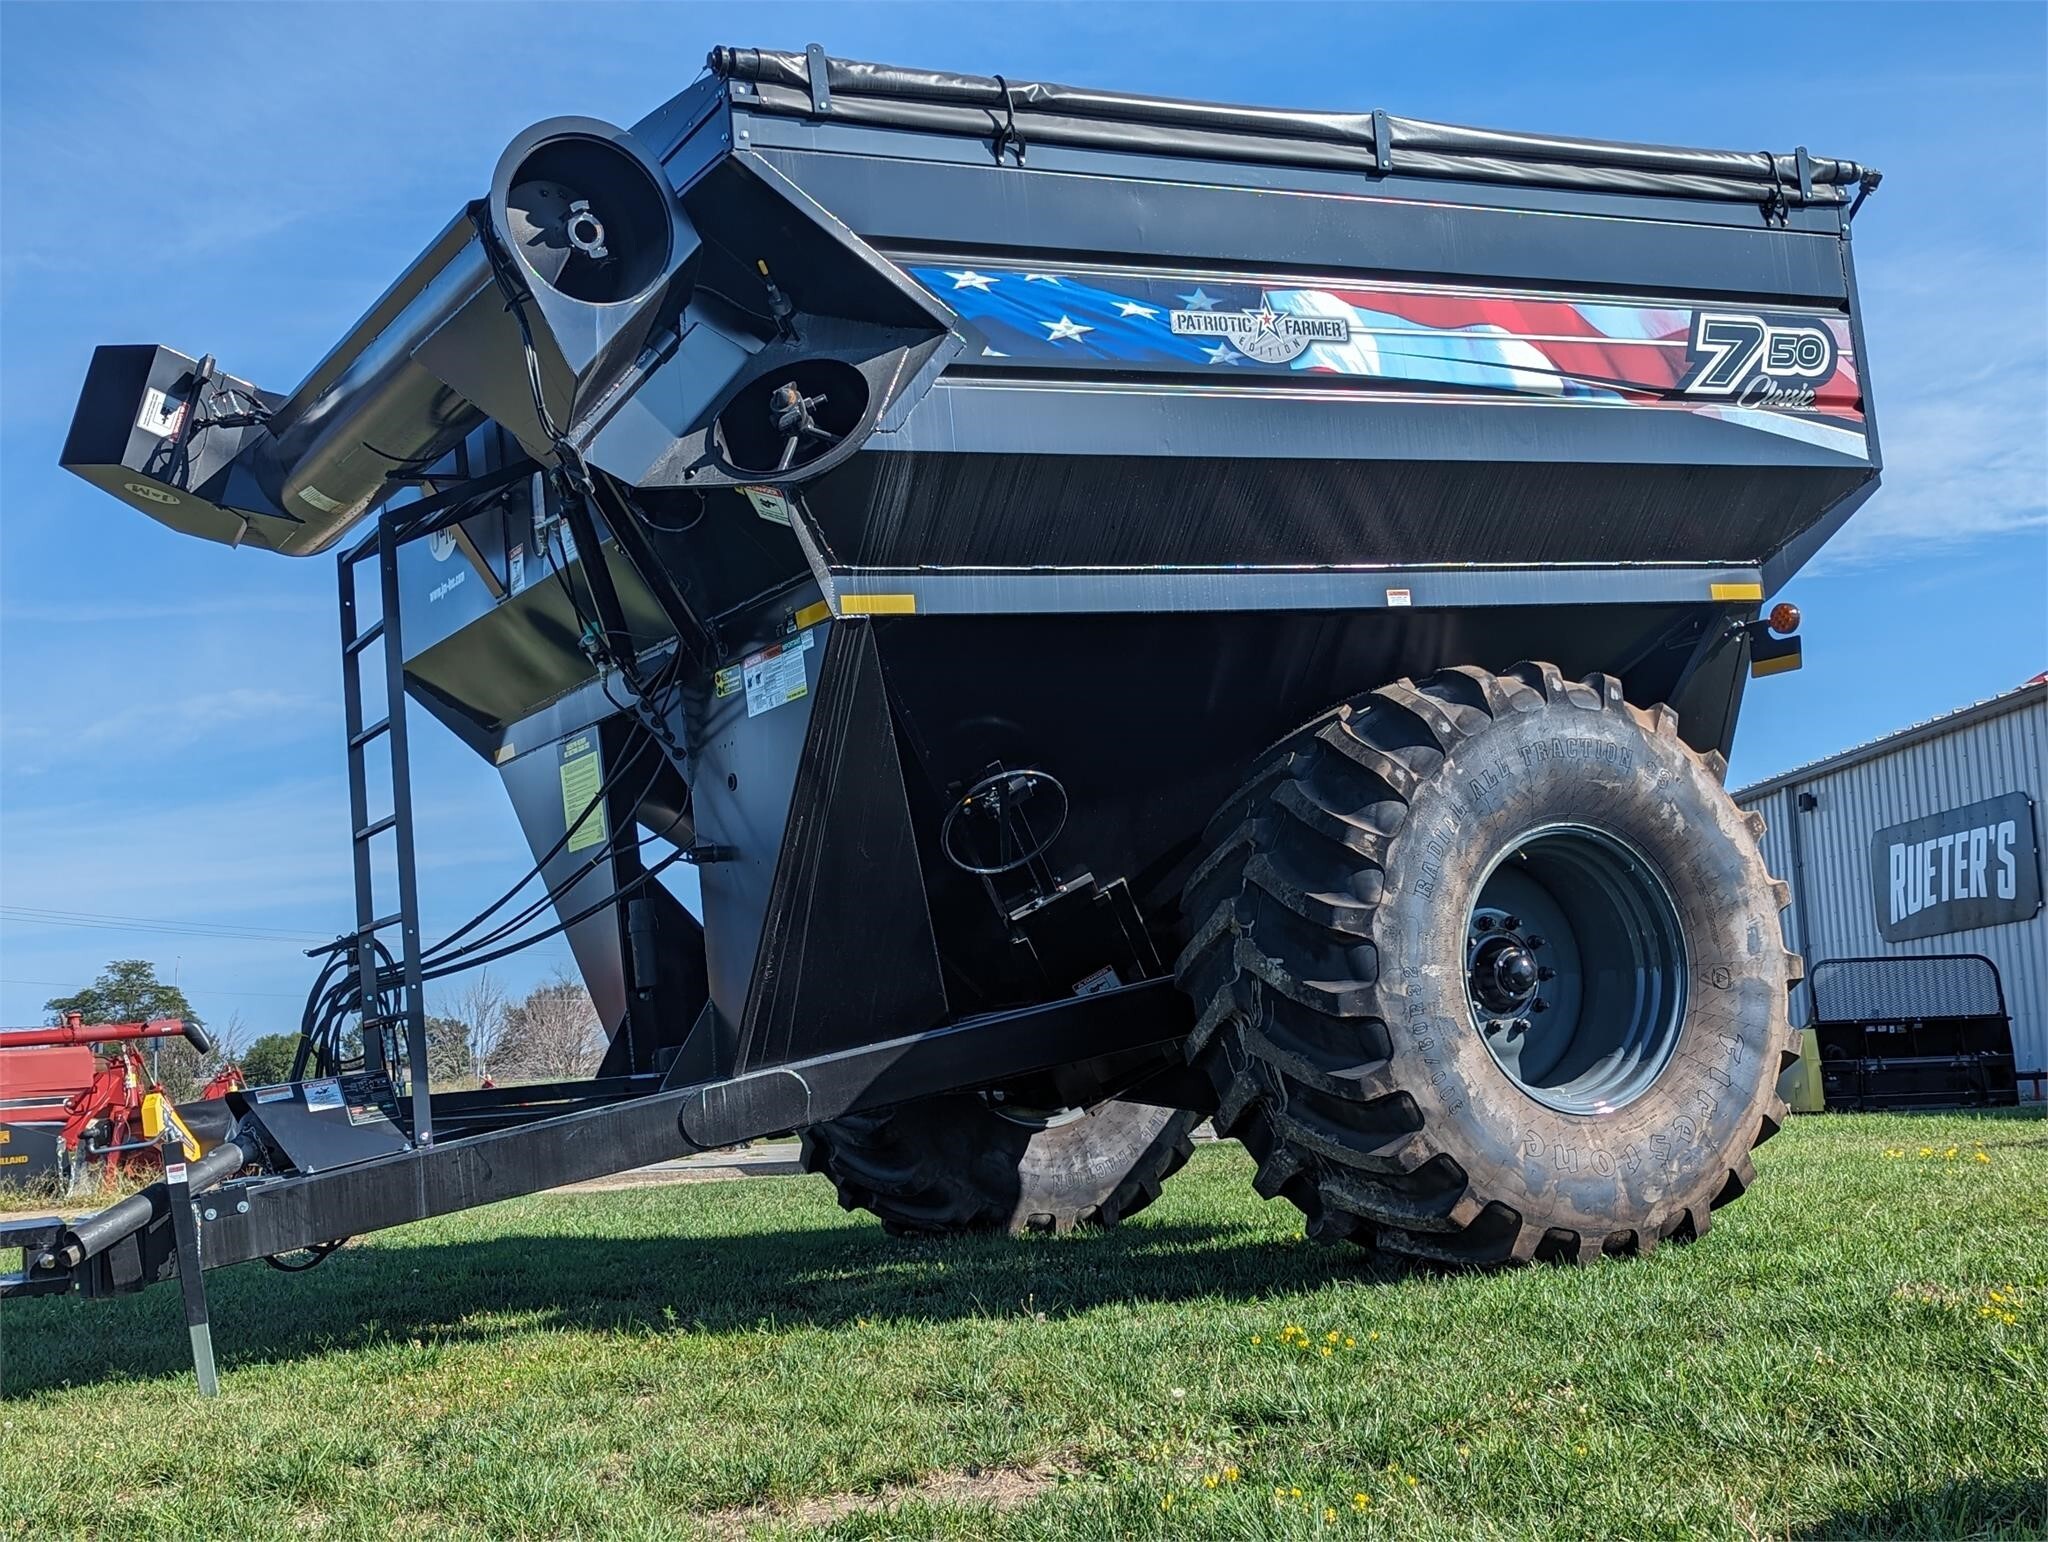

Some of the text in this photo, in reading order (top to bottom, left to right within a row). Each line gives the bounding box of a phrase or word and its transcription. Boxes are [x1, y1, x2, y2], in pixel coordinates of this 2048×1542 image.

[1177, 314, 1341, 337] PATRIOTIC FARMER
[1239, 336, 1300, 357] EDITION
[1684, 313, 1830, 395] 750
[1737, 374, 1817, 409] Classic
[1413, 805, 1467, 901] RADIAL
[1469, 759, 1512, 800] ALL
[1519, 737, 1633, 769] TRACTION
[1890, 820, 2016, 925] RUETER'S
[1523, 1033, 1745, 1177] Firestone
[1052, 1143, 1138, 1193] TRACTION
